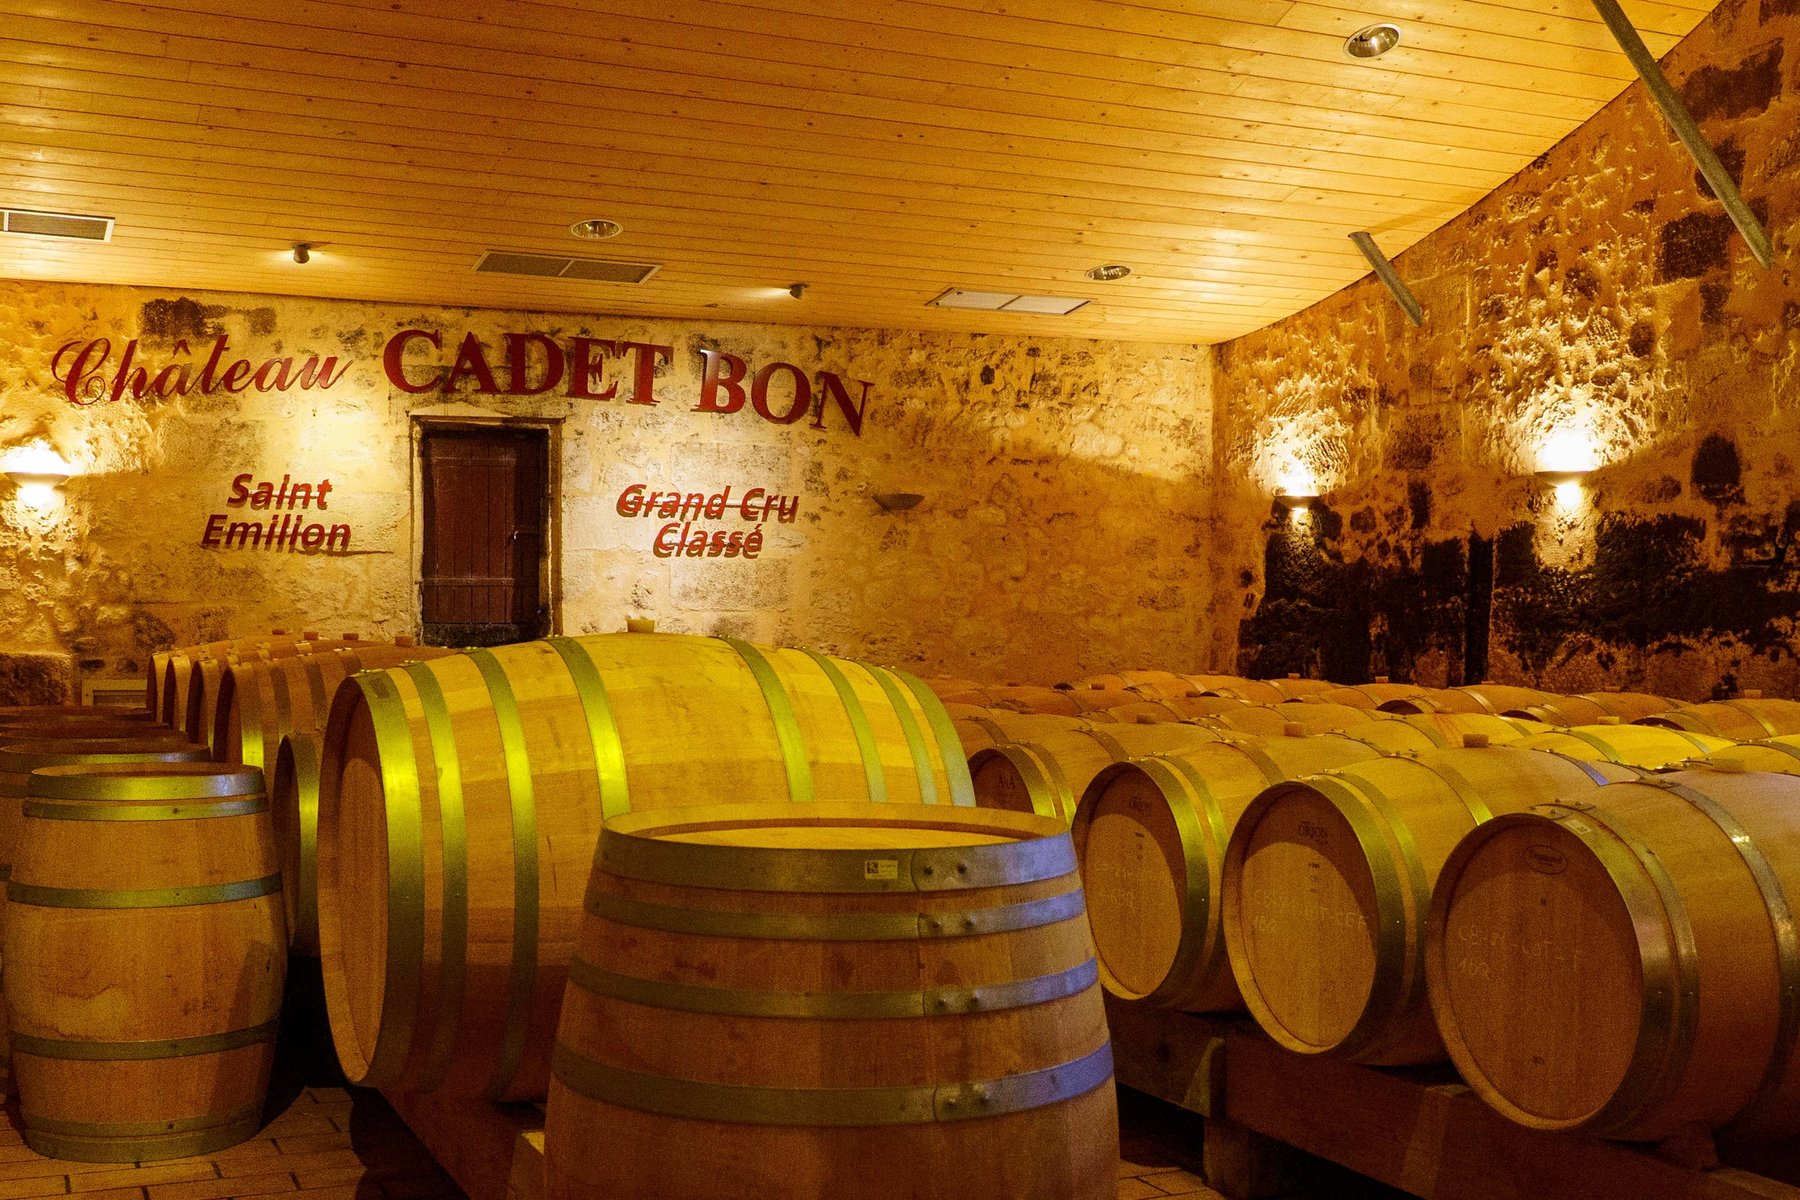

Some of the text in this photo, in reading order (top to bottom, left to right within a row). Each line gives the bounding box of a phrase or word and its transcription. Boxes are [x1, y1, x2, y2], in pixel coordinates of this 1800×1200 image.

[51, 329, 875, 436] Château CADET BON
[227, 473, 333, 511] Saint
[618, 484, 799, 523] Grand Cru
[201, 513, 352, 550] Emilion
[654, 522, 764, 558] Classé
